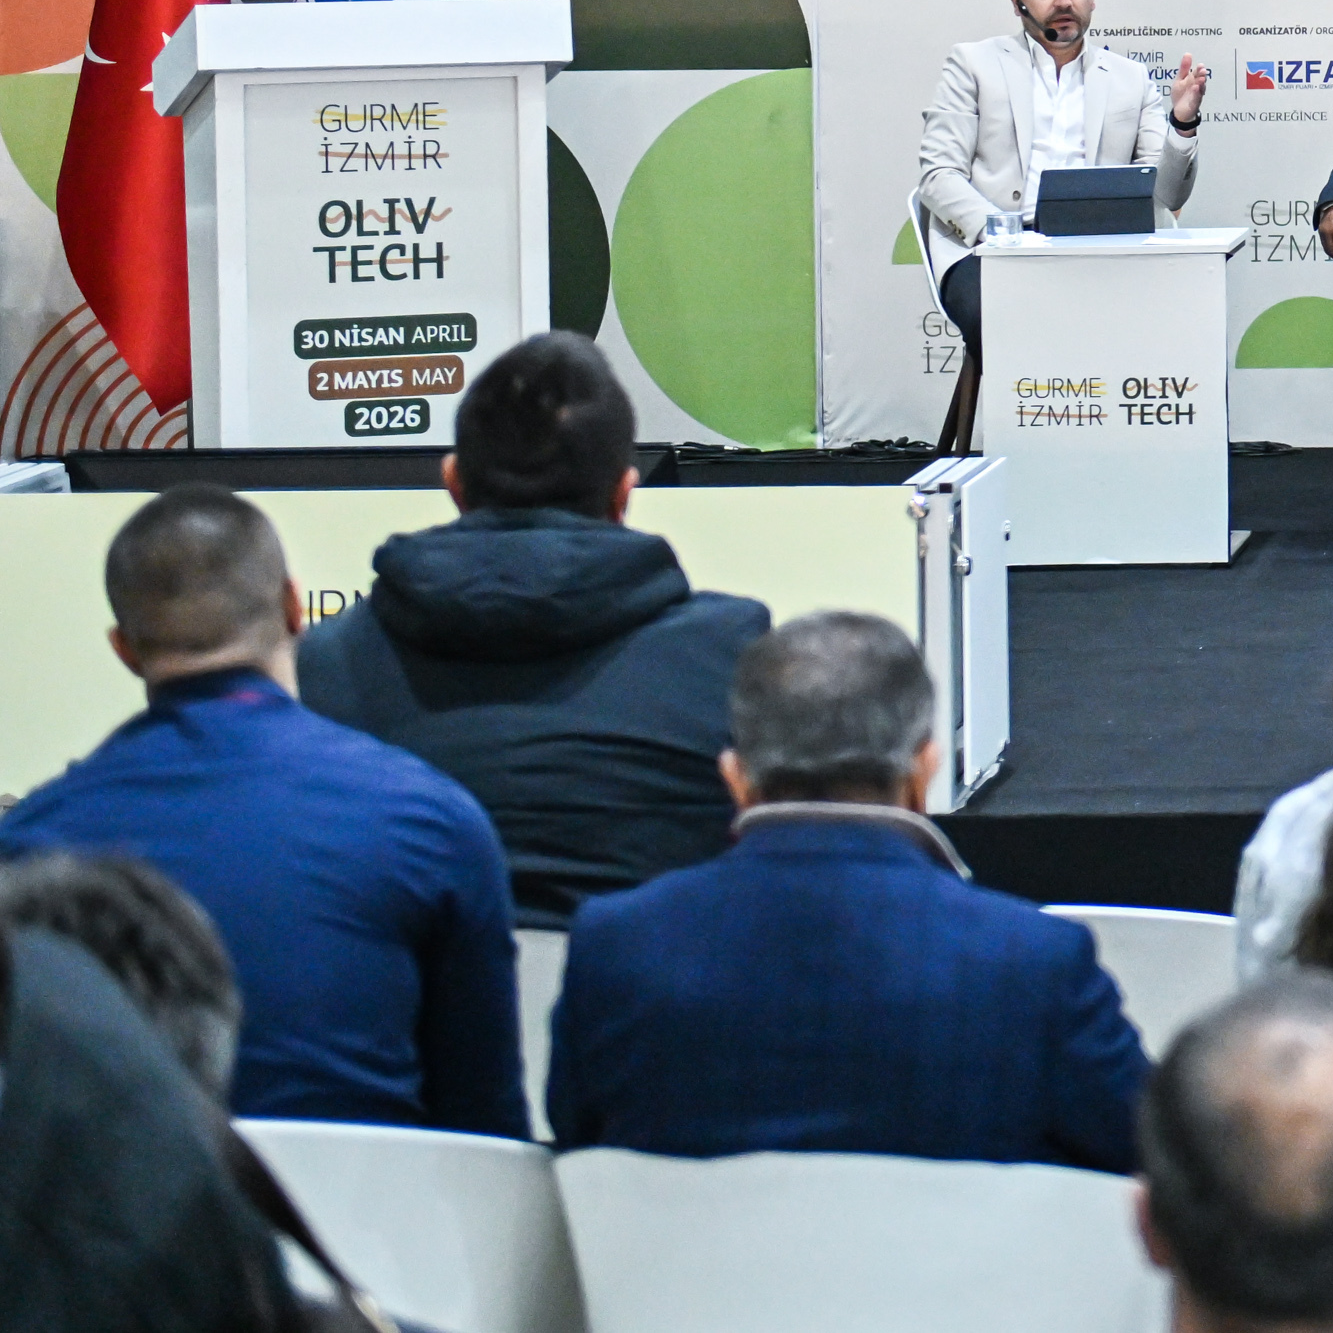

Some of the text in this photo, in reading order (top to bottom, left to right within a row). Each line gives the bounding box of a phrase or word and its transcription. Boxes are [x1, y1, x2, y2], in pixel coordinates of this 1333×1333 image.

[1103, 26, 1173, 36] SAHİPLİĞİNDE
[1181, 28, 1223, 36] HOSTING
[1239, 25, 1308, 35] ORGANİZATÖR
[319, 102, 440, 133] GURME
[1213, 113, 1256, 122] KANUN
[1259, 110, 1328, 122] GEREĞİNCE
[321, 136, 442, 174] İZMİR
[318, 196, 436, 238] OLIV
[312, 242, 445, 283] TECH
[301, 323, 472, 349] 30 NİSAN APRIL
[316, 366, 457, 393] 2 MAYIS MAY
[1017, 378, 1101, 398] GURME
[1122, 377, 1189, 399] OLIV
[354, 405, 421, 430] 2026
[1017, 400, 1103, 427] İZMİR
[1119, 403, 1194, 425] TECH
